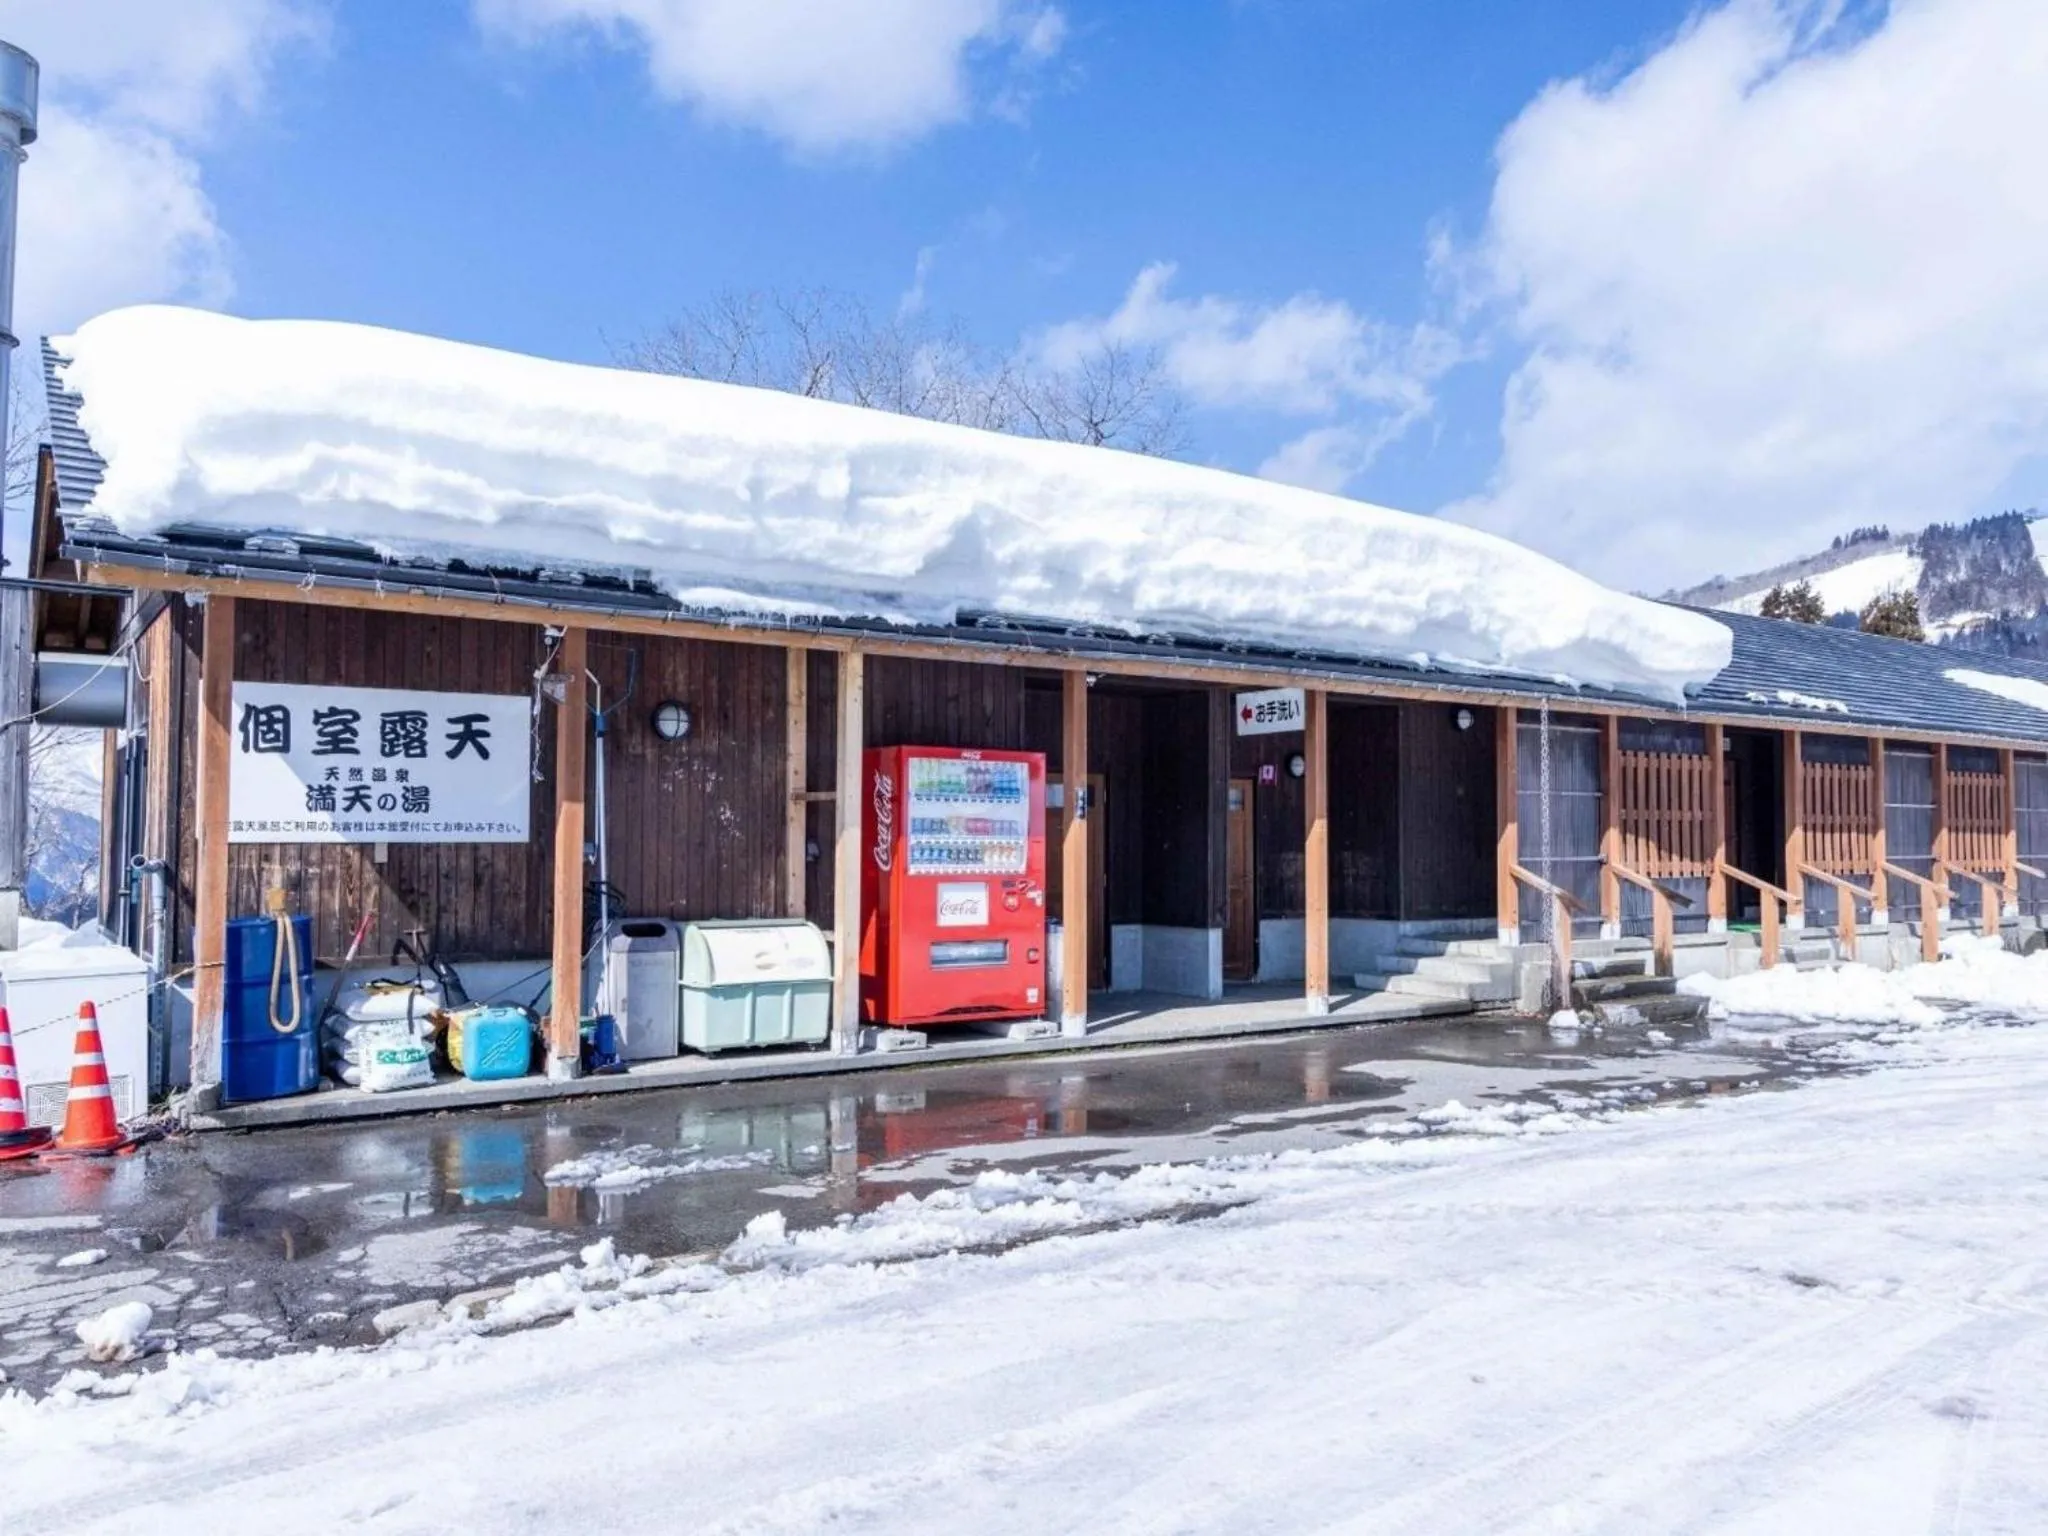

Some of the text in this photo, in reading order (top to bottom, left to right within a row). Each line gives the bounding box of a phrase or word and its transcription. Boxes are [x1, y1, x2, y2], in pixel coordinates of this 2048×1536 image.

[1255, 699, 1301, 723] お手洗い
[238, 702, 492, 761] 個室露天
[324, 766, 410, 782] 天然温泉
[305, 784, 431, 814] 満天の湯
[225, 819, 522, 834] 露天風呂ご利用のお客様は本館受付にてお申込み下さい。
